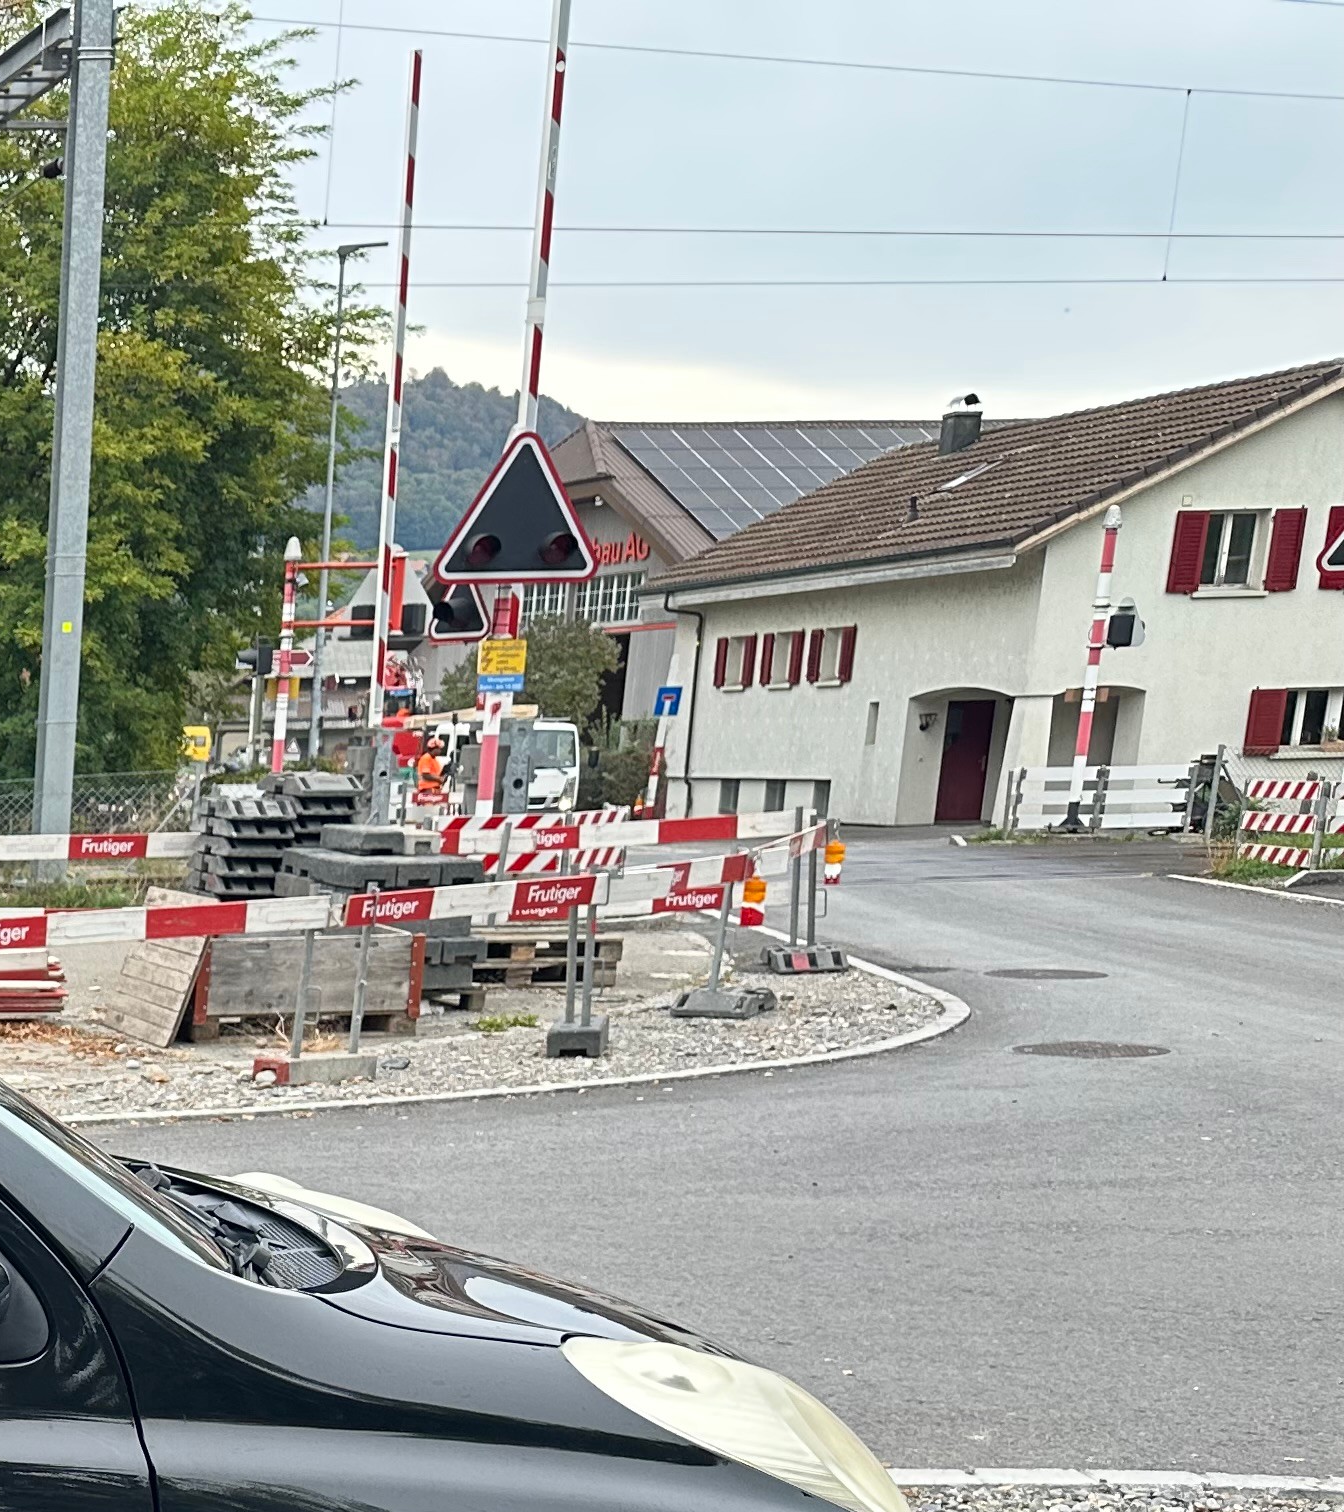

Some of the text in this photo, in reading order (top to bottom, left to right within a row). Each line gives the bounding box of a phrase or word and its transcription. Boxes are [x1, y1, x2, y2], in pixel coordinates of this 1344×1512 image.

[81, 838, 135, 856] Frutiger
[531, 829, 568, 847] tiger
[527, 883, 582, 904] Frutiger
[666, 890, 719, 908] Frutiger
